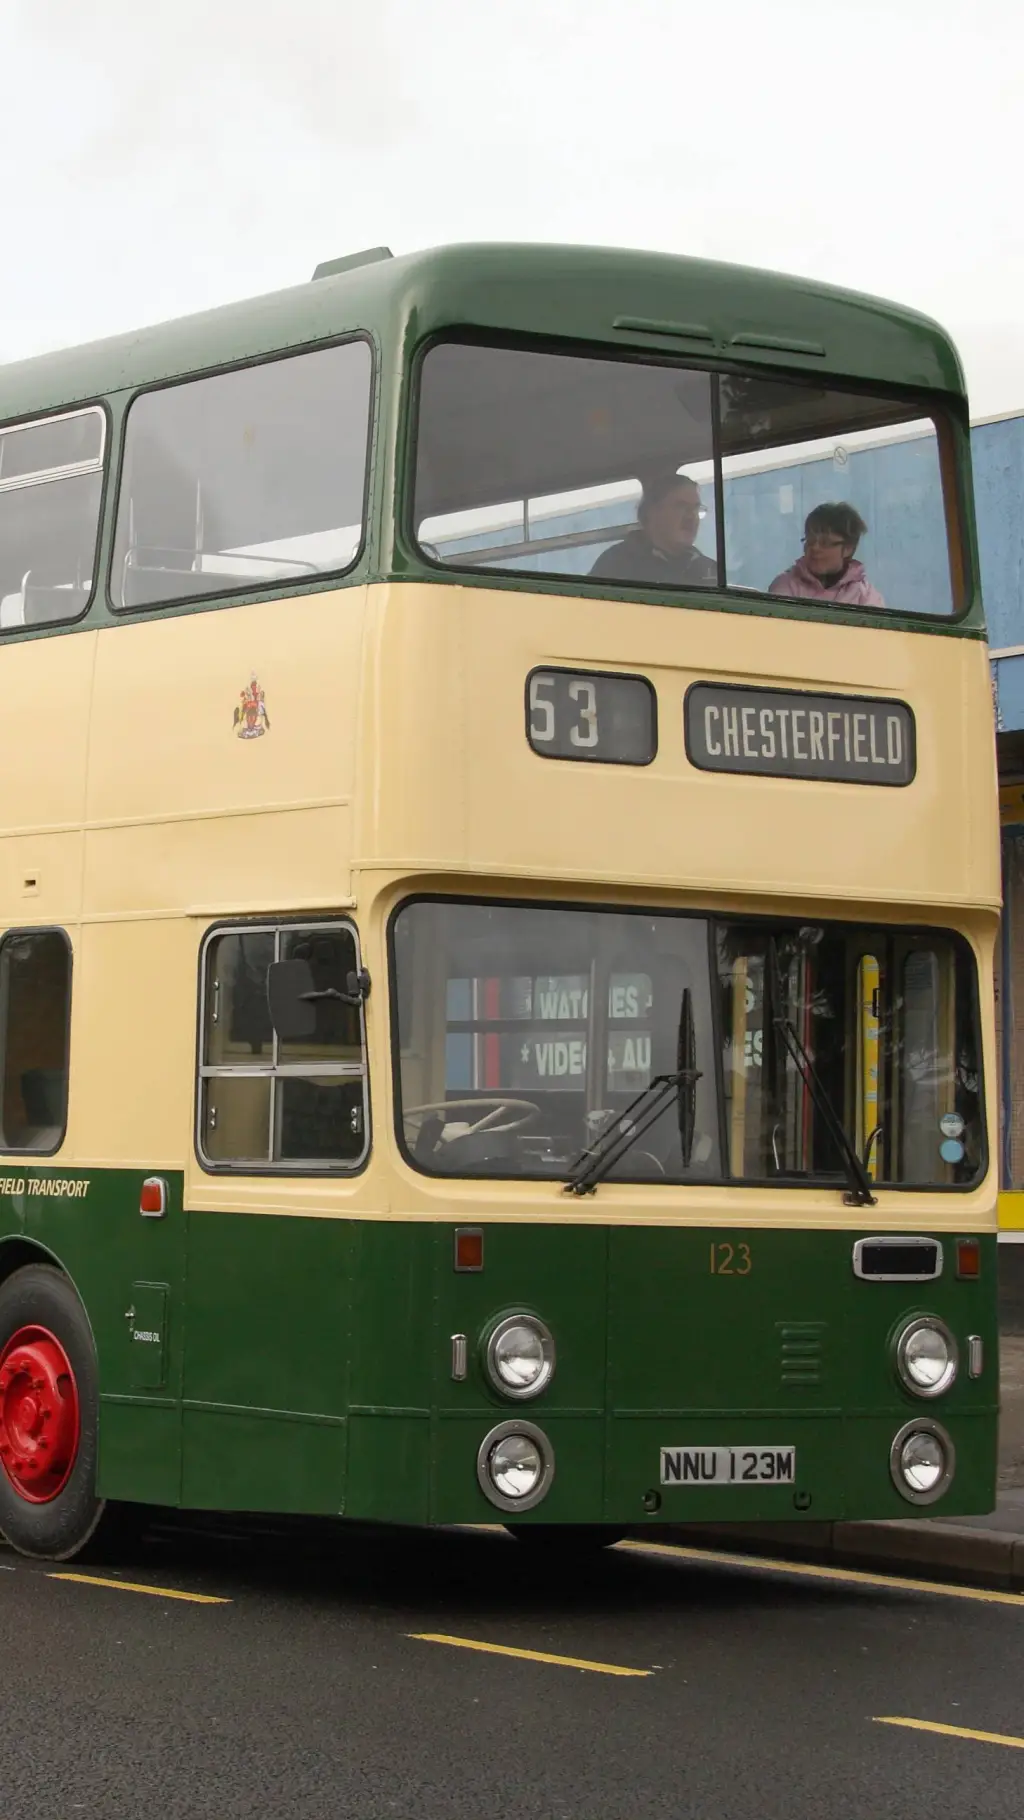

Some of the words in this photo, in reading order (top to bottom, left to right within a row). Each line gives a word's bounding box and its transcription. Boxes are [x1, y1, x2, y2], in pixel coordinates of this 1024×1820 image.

[530, 677, 599, 748] 53
[704, 706, 902, 765] CHESTERFIELD
[27, 1179, 91, 1197] TRANSPORT
[710, 1242, 752, 1275] 123
[664, 1452, 717, 1481] NNU
[730, 1452, 792, 1480] 123M
